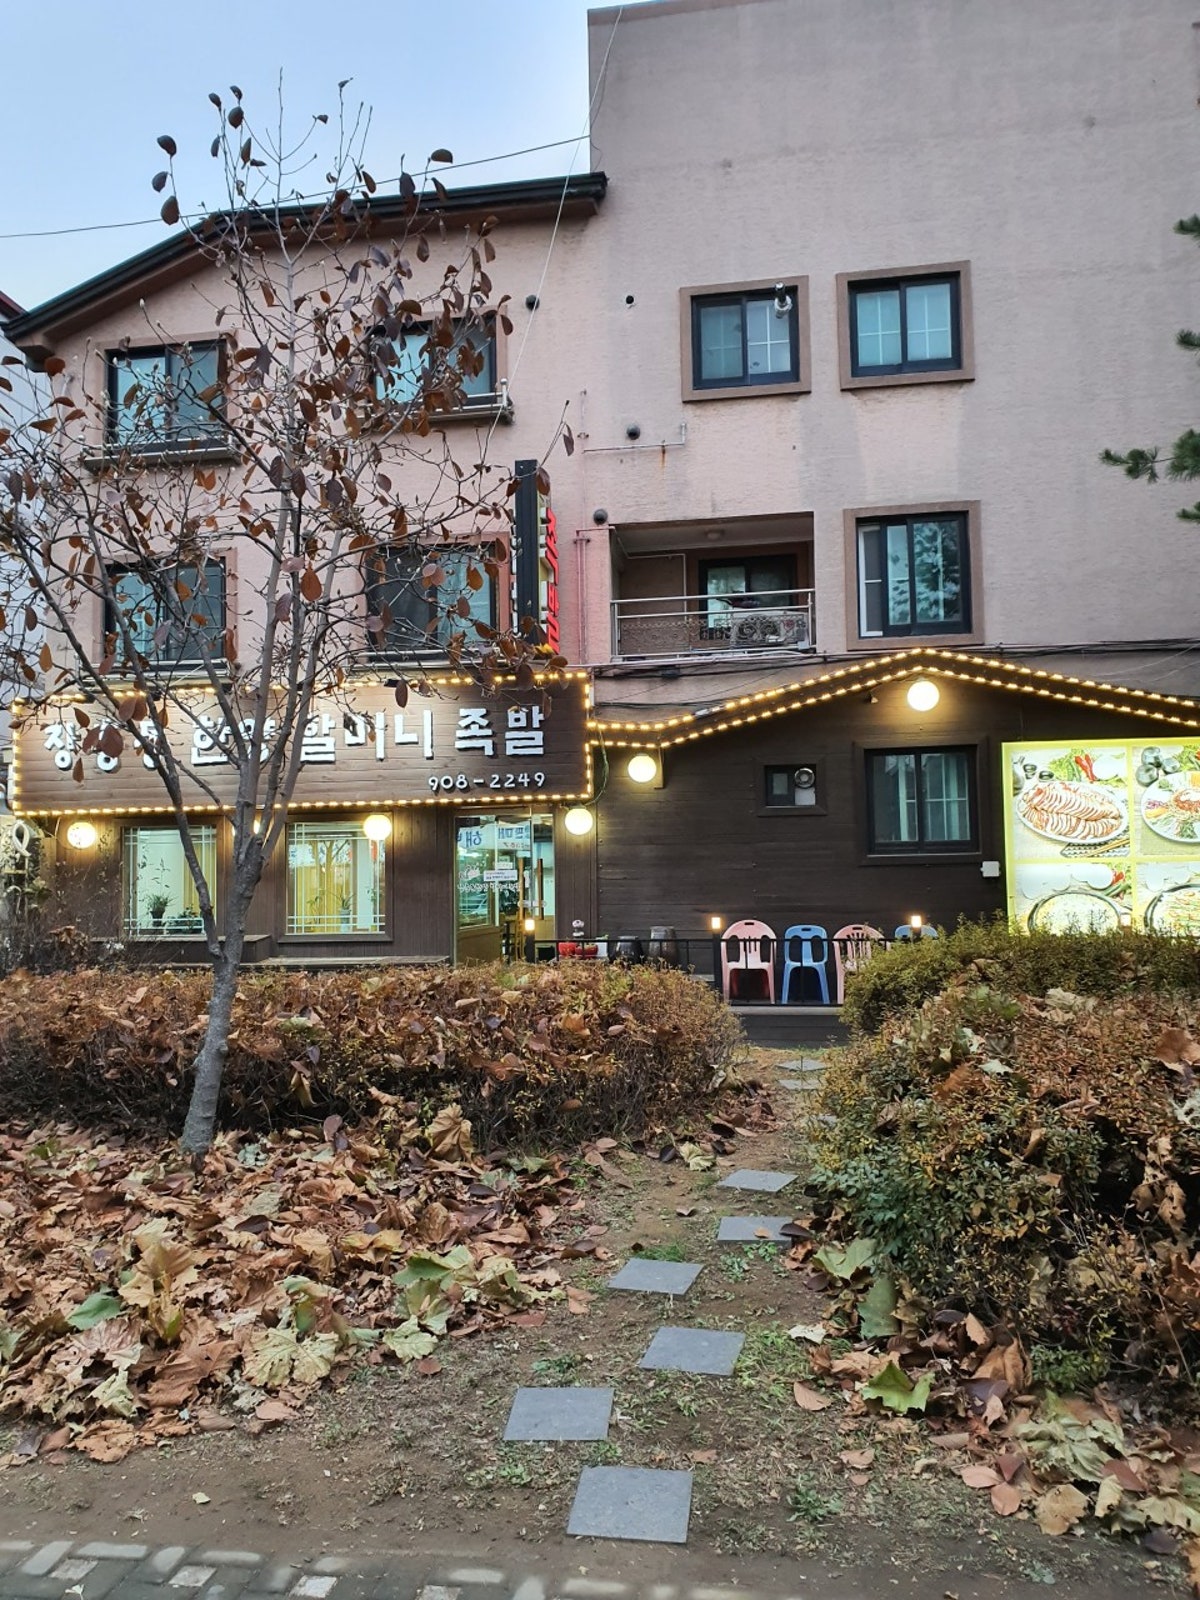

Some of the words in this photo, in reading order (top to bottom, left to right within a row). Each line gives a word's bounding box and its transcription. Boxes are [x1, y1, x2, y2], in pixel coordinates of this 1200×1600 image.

[300, 709, 433, 763] 할머니
[454, 705, 545, 757] 족발
[427, 772, 546, 791] 908-2249
